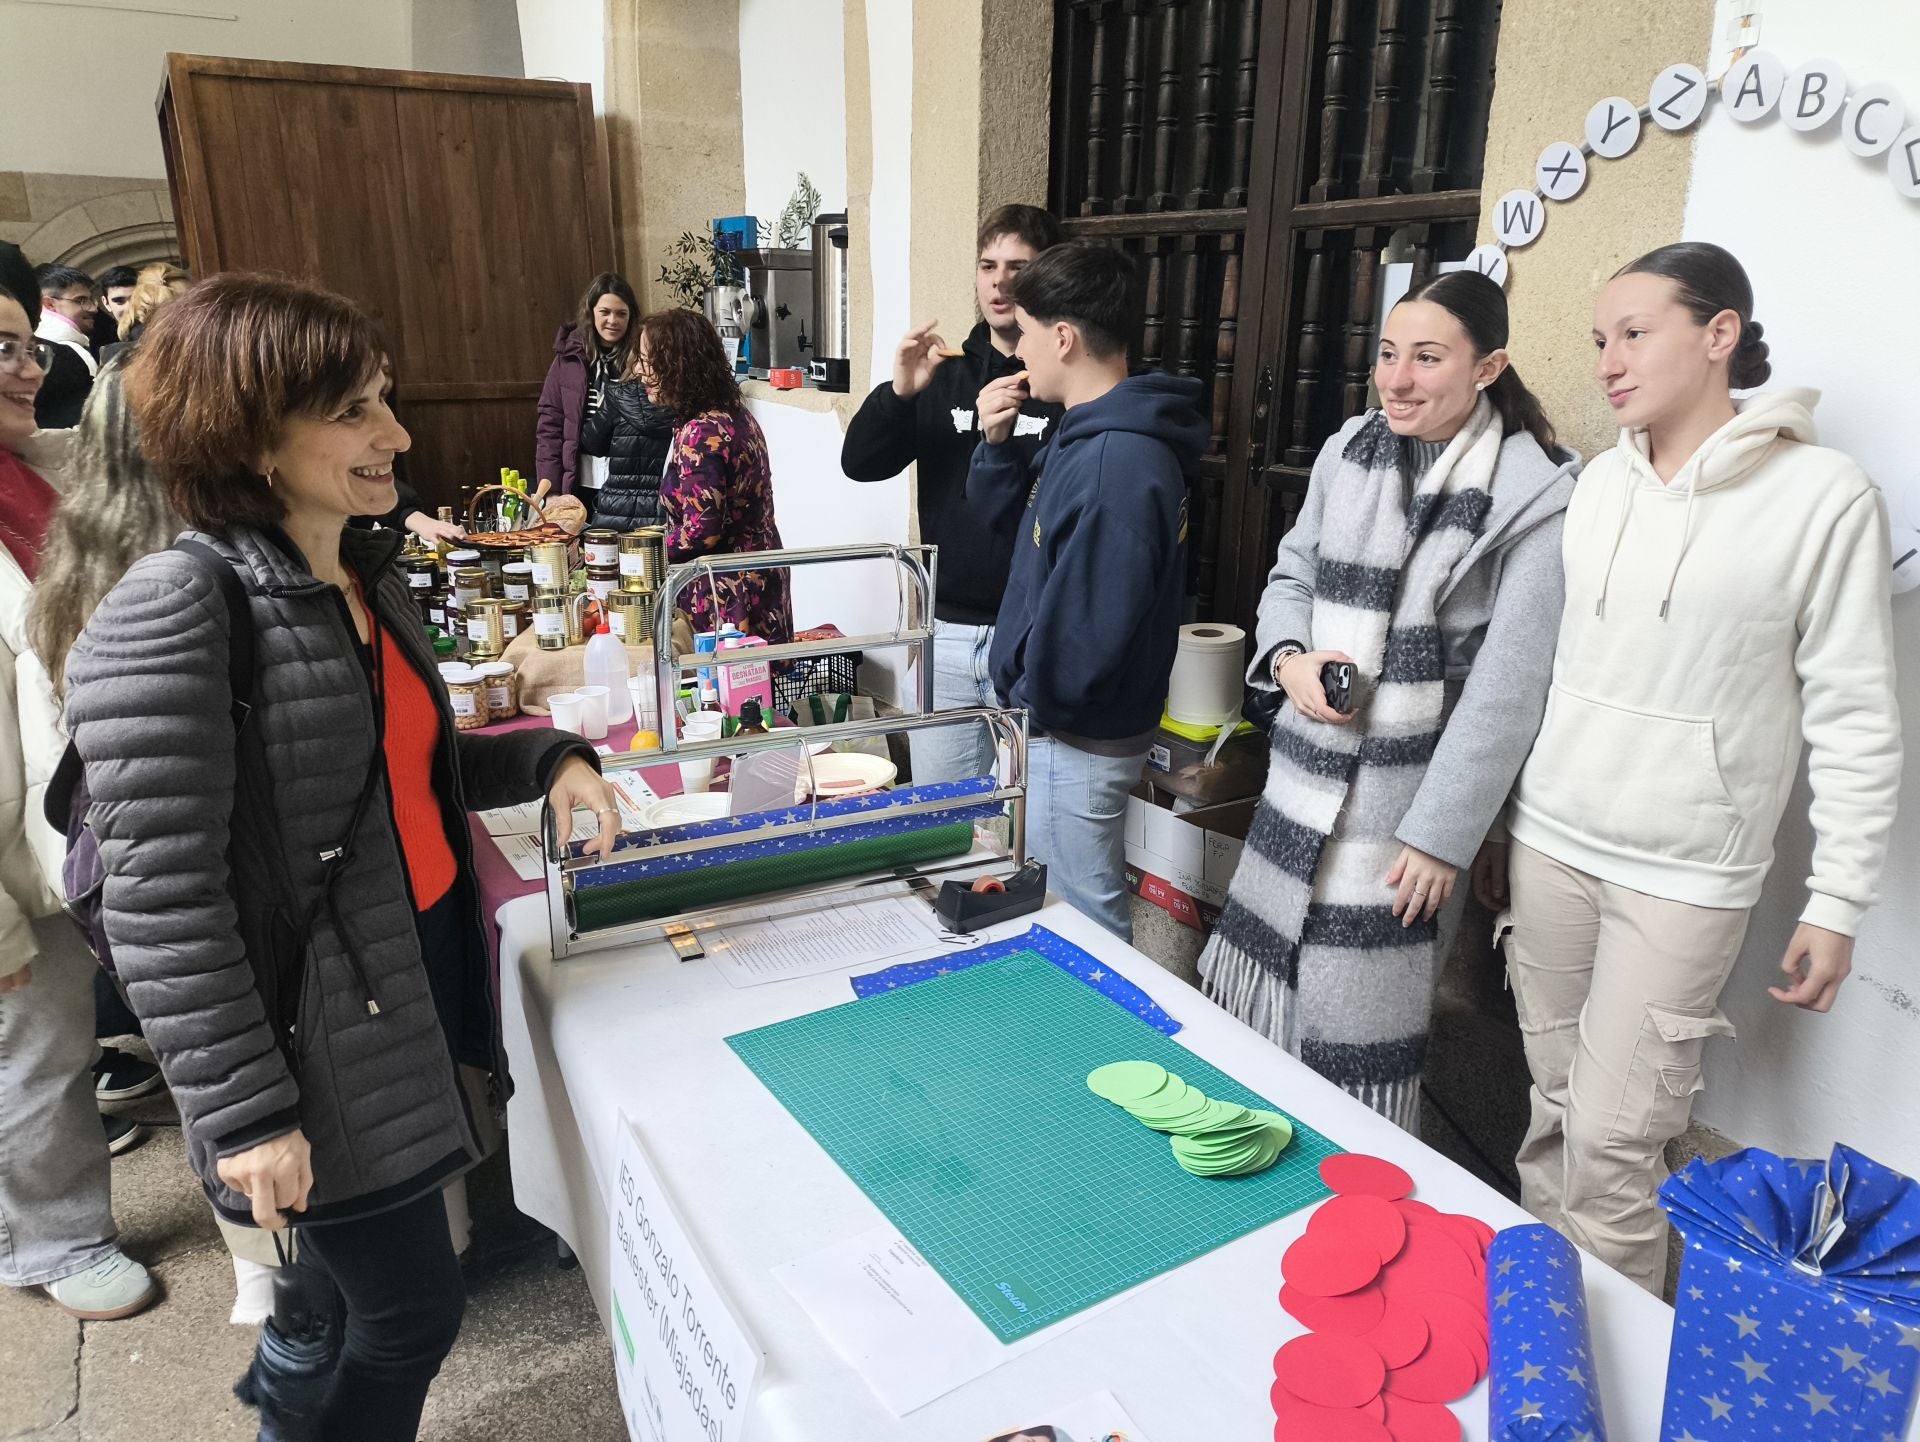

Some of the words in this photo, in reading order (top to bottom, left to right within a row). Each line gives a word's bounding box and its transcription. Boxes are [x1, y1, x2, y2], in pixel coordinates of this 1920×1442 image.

[1503, 200, 1535, 234] W
[1541, 150, 1579, 190] X
[1600, 104, 1631, 144] Y
[1657, 73, 1697, 120] Z
[1734, 64, 1765, 109] A
[1797, 72, 1828, 118] B
[1854, 97, 1890, 145] C
[732, 666, 766, 680] DESNATADA
[616, 1210, 658, 1318] Ballester
[619, 1159, 635, 1207] IES
[635, 1196, 678, 1298] Gonzalo
[682, 1283, 736, 1410] Torrente
